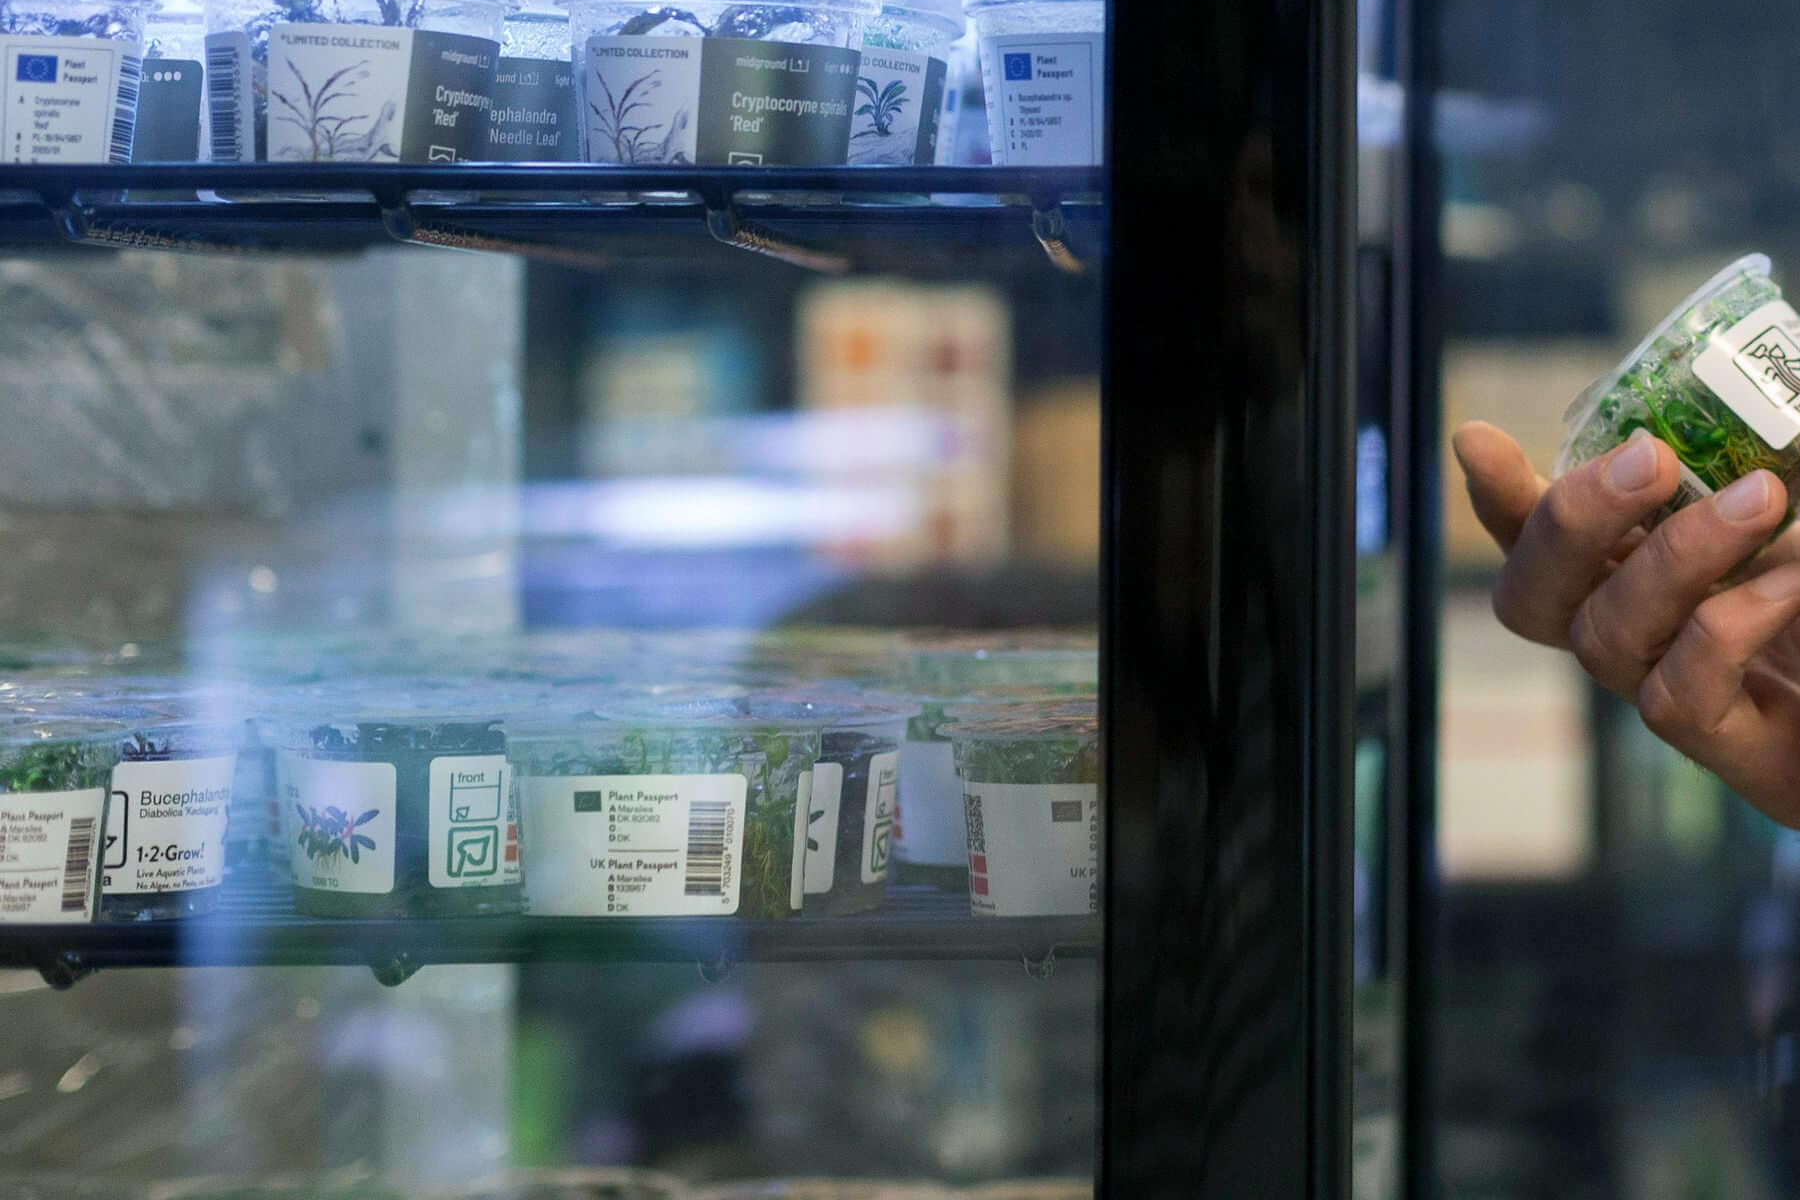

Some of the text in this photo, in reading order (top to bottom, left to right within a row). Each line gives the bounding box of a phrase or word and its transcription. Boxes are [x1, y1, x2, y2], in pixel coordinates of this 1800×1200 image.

[331, 37, 400, 50] COLLECTION
[627, 47, 689, 60] COLLECTION
[735, 55, 788, 72] midground
[872, 59, 921, 74] COLLECTION
[732, 91, 817, 116] Cryptocoryne
[730, 115, 764, 133] 'Red'
[457, 771, 485, 784] front
[608, 791, 679, 805] Plant Passport
[609, 804, 616, 813] A
[1, 809, 64, 824] Plant Passport
[137, 869, 154, 879] Live
[156, 866, 185, 880] Aquatic
[590, 859, 678, 873] UK Plant Passport
[1071, 867, 1087, 878] UK
[608, 874, 615, 882] A
